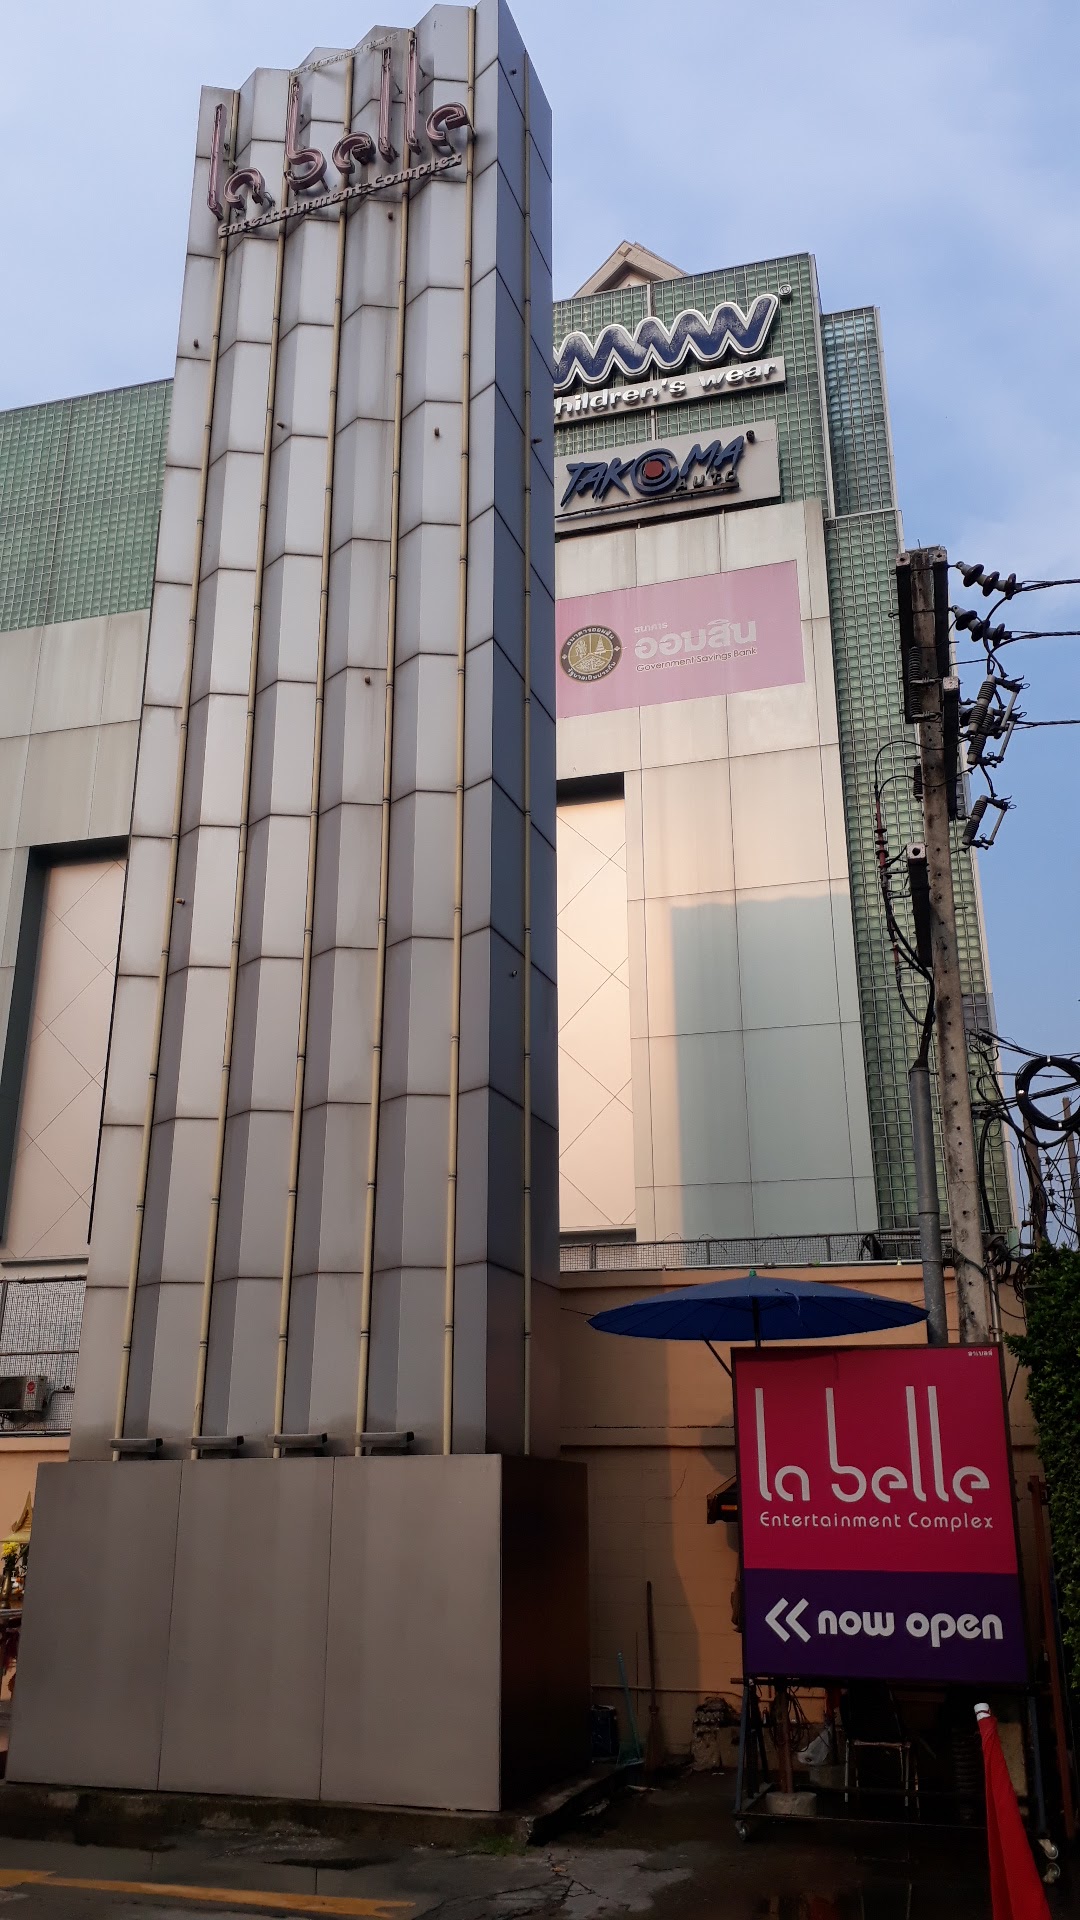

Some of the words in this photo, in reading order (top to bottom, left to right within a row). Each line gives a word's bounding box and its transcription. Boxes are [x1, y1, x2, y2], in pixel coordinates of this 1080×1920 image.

[207, 103, 266, 219] la
[284, 37, 470, 193] belle
[217, 180, 371, 238] Entertainment
[371, 152, 463, 196] Complex
[554, 378, 686, 417] hildren's
[698, 362, 777, 391] wear
[560, 435, 745, 508] TAKOMA
[634, 618, 757, 659] ออมสิน
[636, 656, 695, 672] Government
[696, 651, 732, 663] Savings
[733, 647, 757, 658] Bank
[755, 1387, 810, 1502] la
[825, 1385, 990, 1504] belle
[759, 1511, 901, 1528] Entertainment
[908, 1512, 993, 1532] Complex
[817, 1610, 895, 1637] now
[905, 1612, 1004, 1648] open
